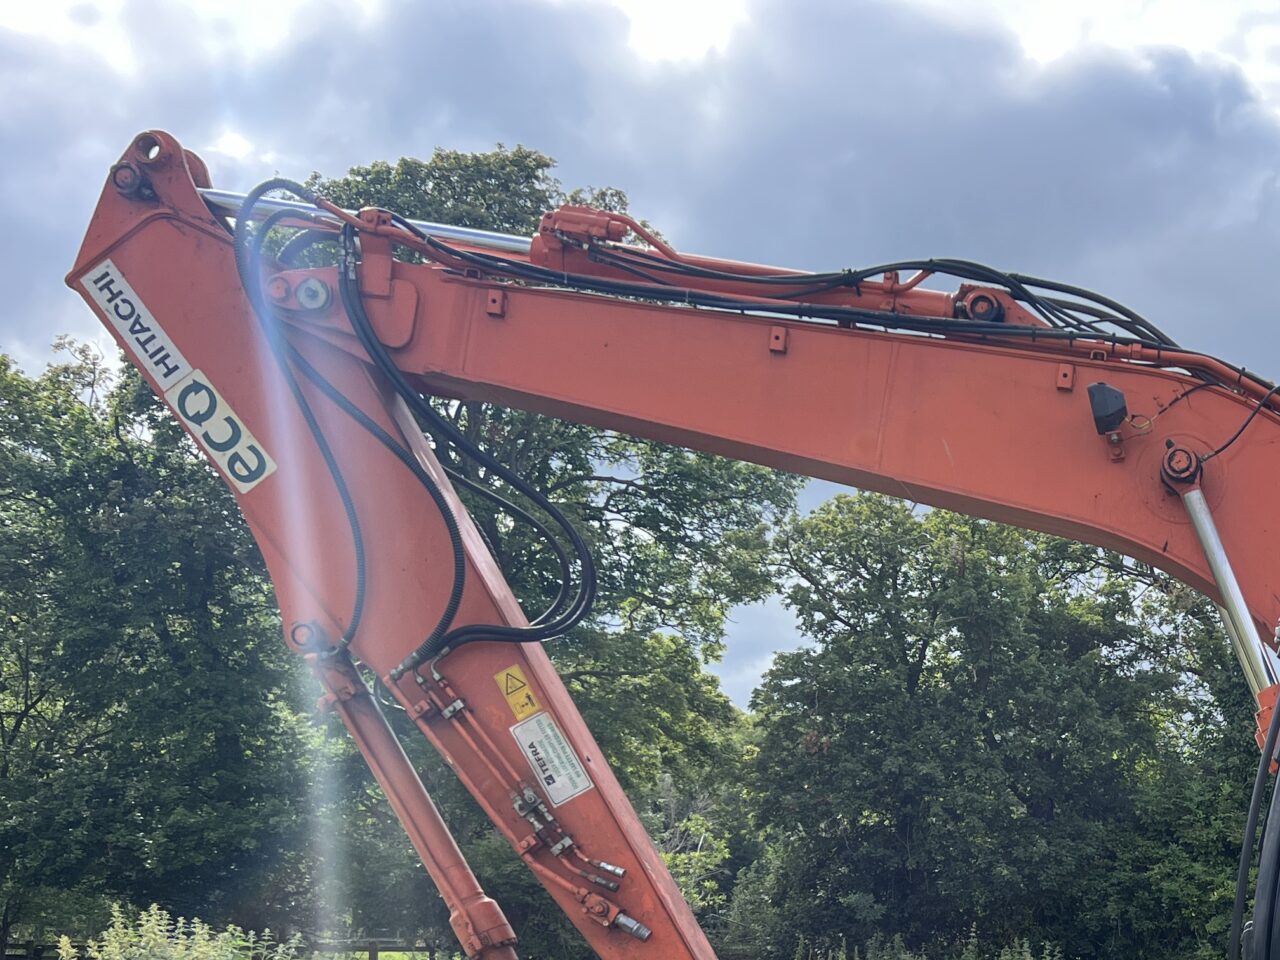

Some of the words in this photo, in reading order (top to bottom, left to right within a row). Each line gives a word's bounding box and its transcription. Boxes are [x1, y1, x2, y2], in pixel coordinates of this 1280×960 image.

[93, 271, 180, 378] HITACHI
[178, 379, 266, 483] eco
[528, 742, 550, 775] TEFRA
